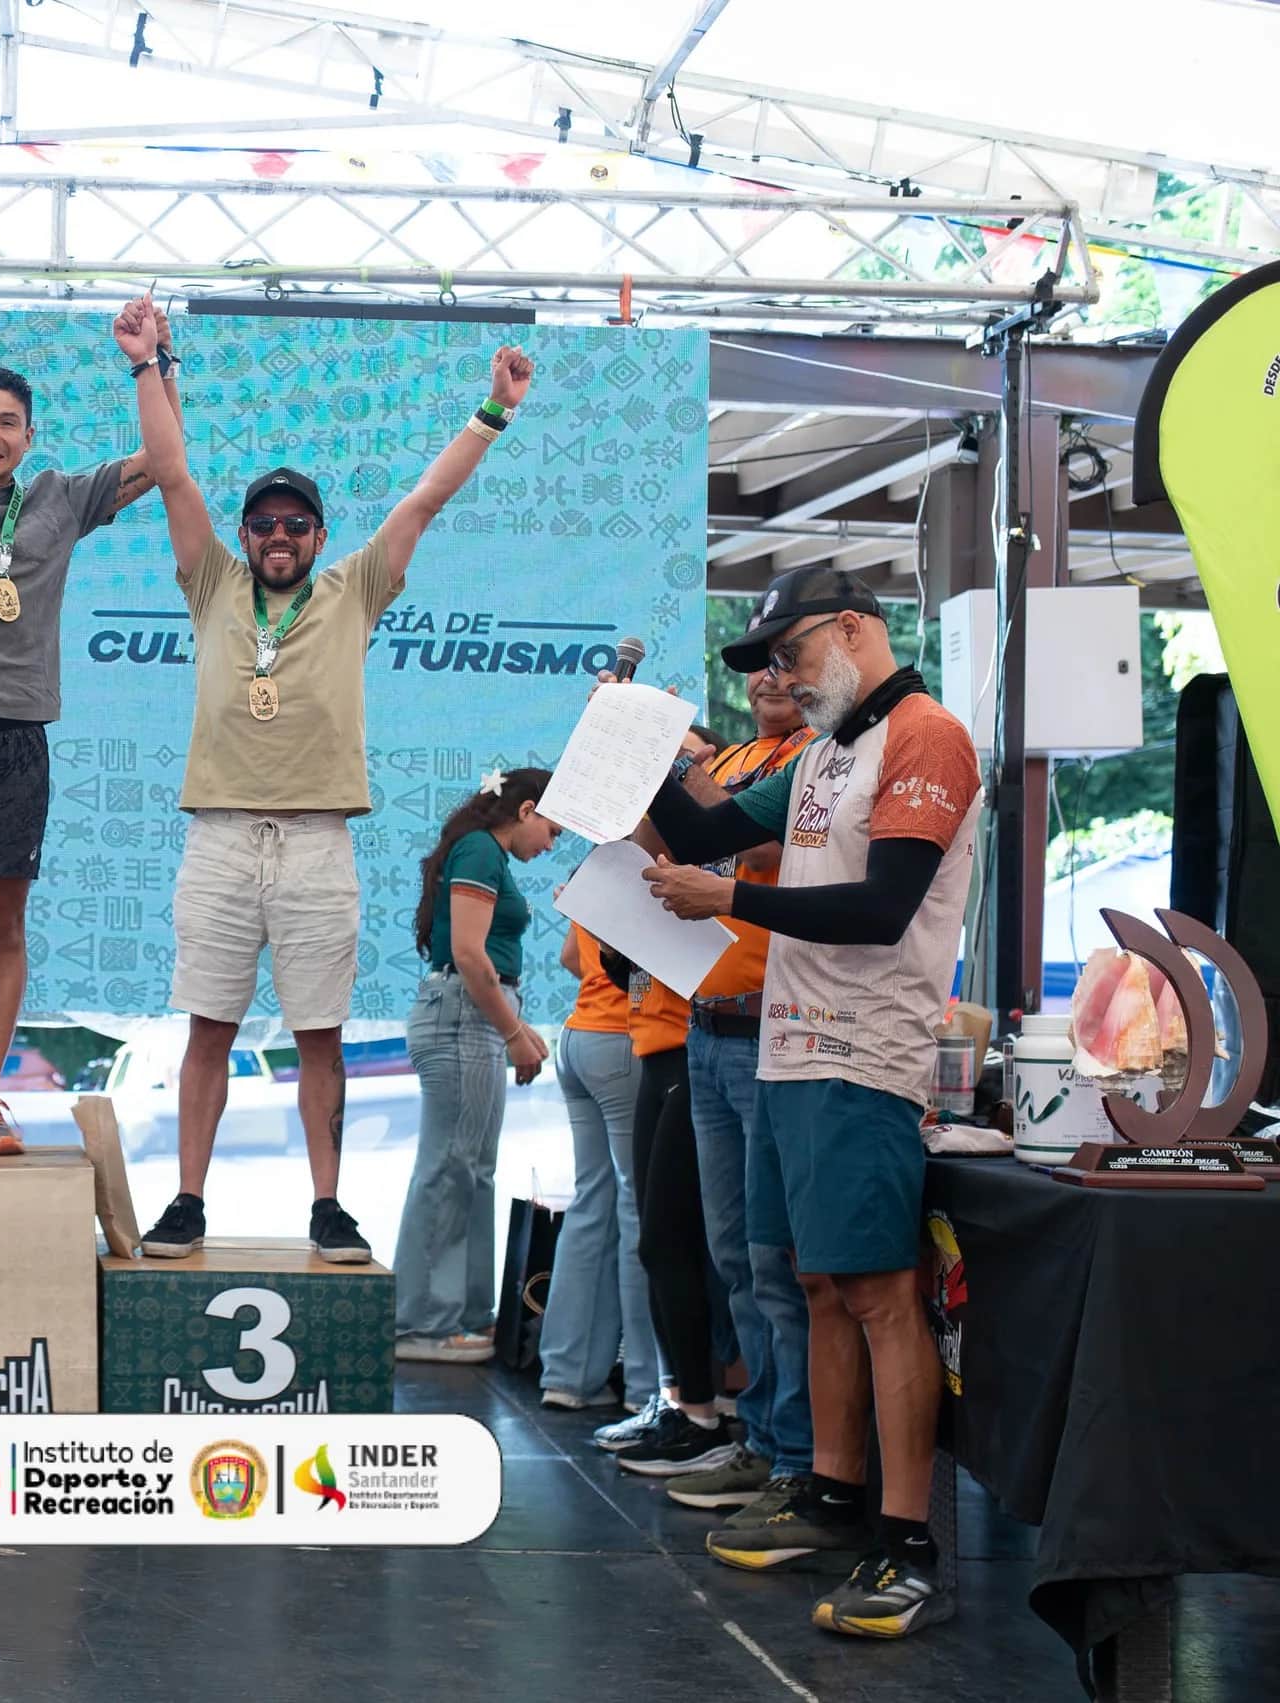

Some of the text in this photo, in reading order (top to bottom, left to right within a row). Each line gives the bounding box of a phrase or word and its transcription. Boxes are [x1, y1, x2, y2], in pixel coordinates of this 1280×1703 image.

[445, 612, 493, 634] DE
[389, 638, 617, 677] TURISMO
[1142, 1148, 1193, 1158] CAMPEÓN
[201, 1287, 296, 1401] 3
